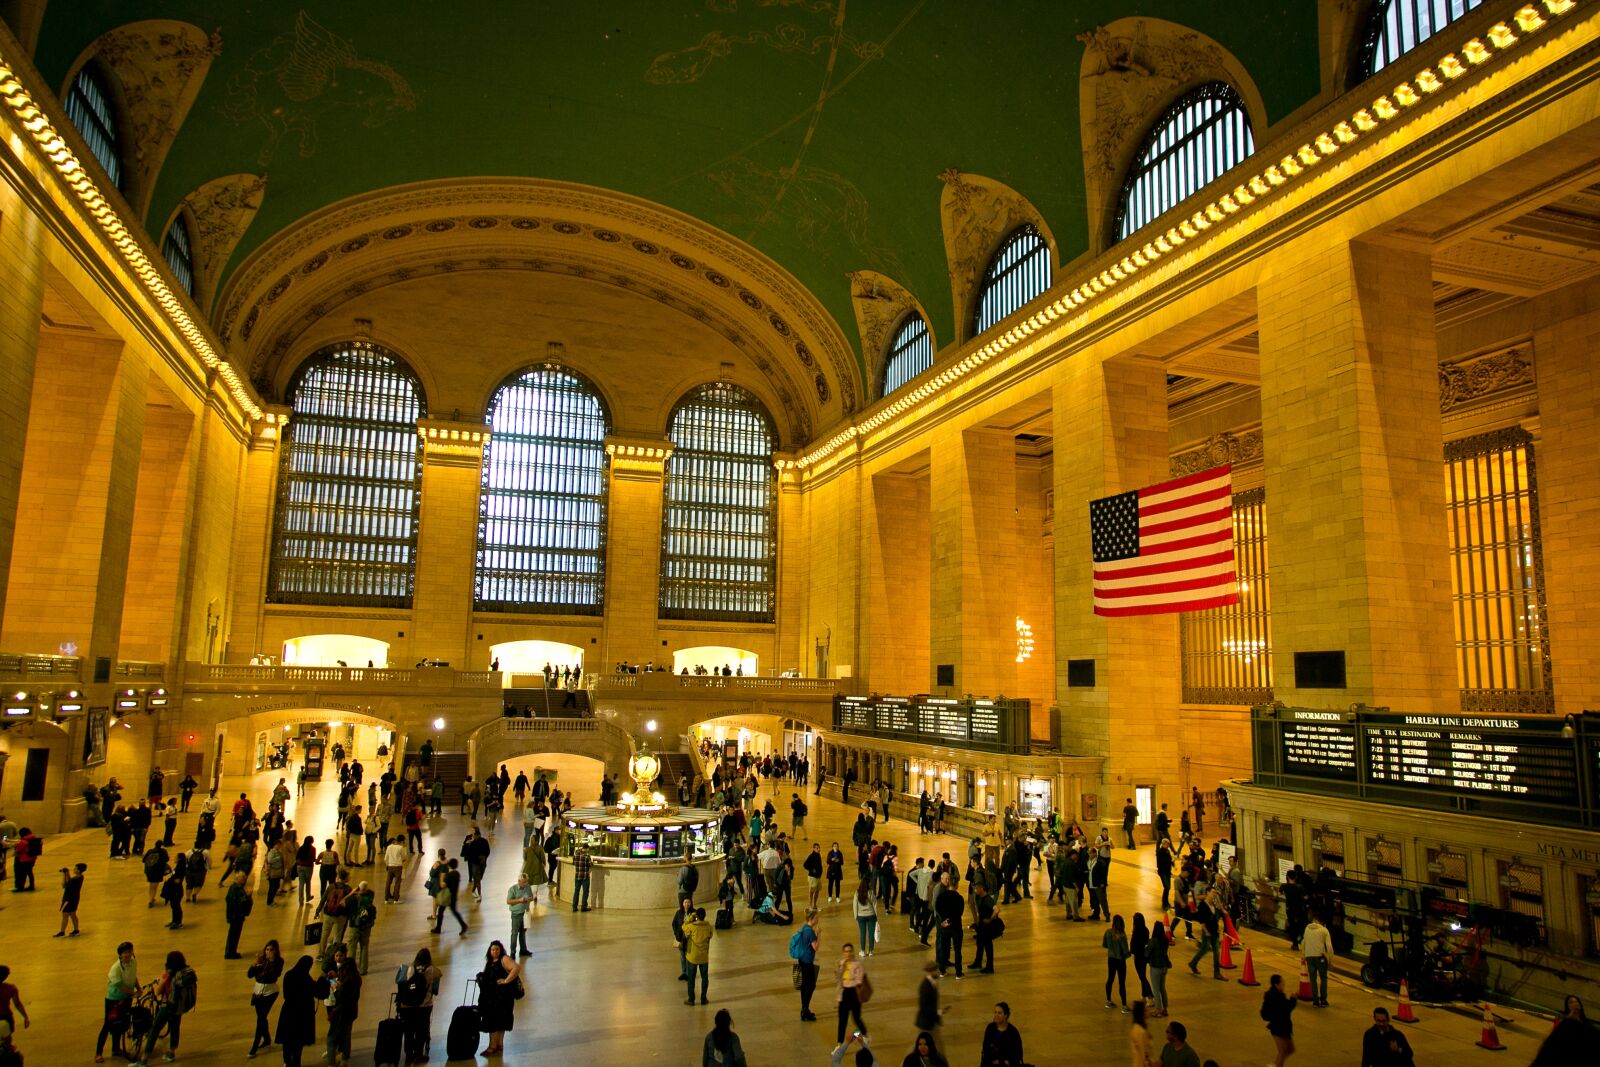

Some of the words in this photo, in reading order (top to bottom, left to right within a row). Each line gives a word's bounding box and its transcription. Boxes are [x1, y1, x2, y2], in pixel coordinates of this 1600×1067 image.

[1295, 712, 1340, 720] INFORMATION
[1406, 716, 1439, 724] HARLEM
[1441, 718, 1460, 726] LINE
[1463, 718, 1519, 728] DEPARTURES
[1537, 842, 1566, 857] MTA
